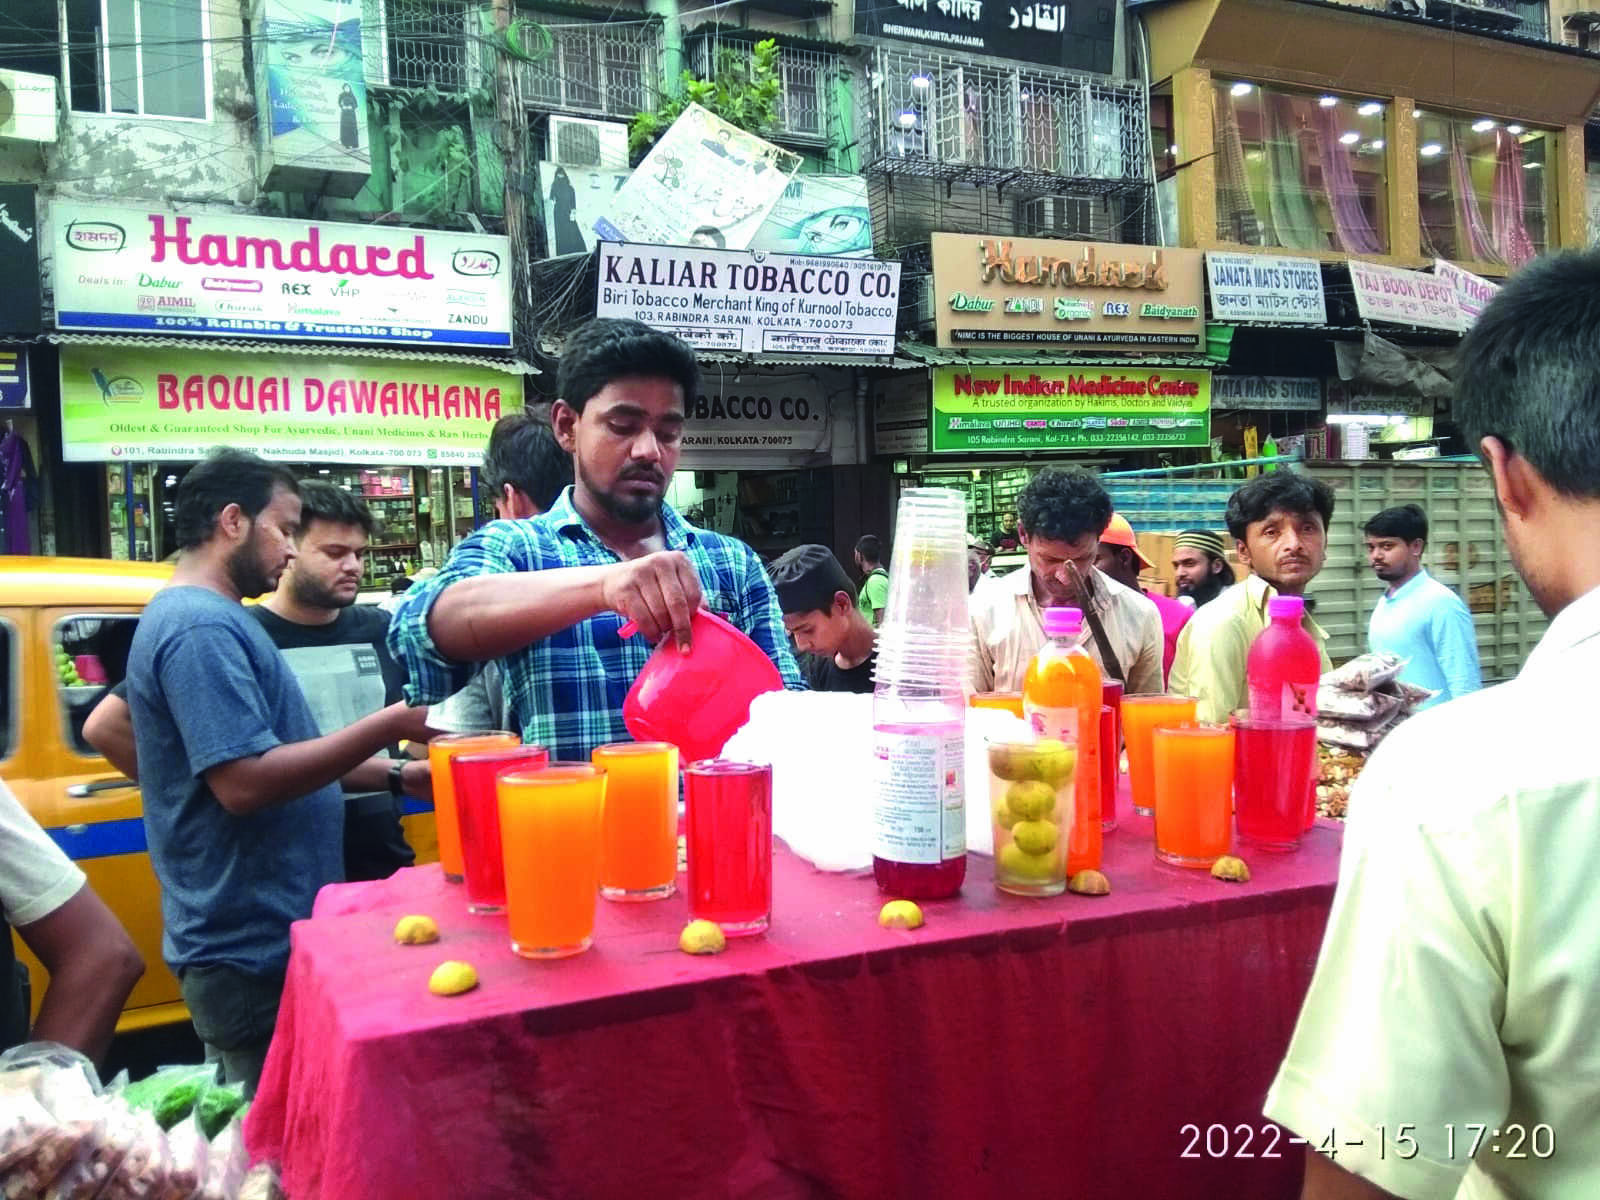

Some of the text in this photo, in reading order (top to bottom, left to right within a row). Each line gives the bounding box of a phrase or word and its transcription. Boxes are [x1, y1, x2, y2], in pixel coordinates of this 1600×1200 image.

[148, 214, 434, 280] Hamdard
[138, 272, 183, 289] Dabur
[605, 255, 896, 298] KALIAR TOBACCO CO.
[1214, 265, 1319, 291] JANATA MATS STORES
[281, 283, 312, 296] REX
[330, 287, 360, 297] VHP
[1355, 271, 1456, 304] TAJ BOOK DEPOT
[603, 288, 628, 305] Biri
[632, 290, 688, 309] Tobacco
[693, 293, 752, 312] Merchant
[755, 295, 779, 314] King
[782, 298, 796, 312] of
[798, 298, 843, 316] Kurnool
[952, 293, 995, 312] Dabur
[1106, 302, 1129, 315] REX
[448, 313, 488, 325] ZANDU
[658, 311, 710, 323] RABINDRA
[1143, 303, 1198, 319] Baidyanath
[207, 319, 282, 331] Reliable
[303, 322, 388, 336] Trustable
[391, 327, 433, 339] Shop
[978, 332, 986, 340] IS
[987, 332, 1001, 340] THE
[1003, 333, 1035, 341] BIGGEST
[1036, 333, 1060, 341] HOUSE
[1062, 333, 1072, 341] OF
[1073, 334, 1096, 342] UNANI
[1102, 335, 1139, 343] AYURVEDA
[1139, 335, 1147, 343] IN
[1147, 335, 1178, 343] EASTERN
[954, 374, 1000, 396] New
[1004, 374, 1064, 396] Indian
[1068, 374, 1147, 397] Medicine
[157, 373, 501, 422] BAQUAI DAWAKHANA
[972, 398, 979, 408] A
[982, 398, 1016, 408] trusted
[1017, 398, 1073, 410] organization
[1074, 398, 1085, 410] by
[1121, 397, 1150, 408] Doctors
[1151, 397, 1166, 408] and
[780, 397, 819, 421] CO.
[110, 423, 146, 433] Oldest
[967, 435, 981, 444] 105
